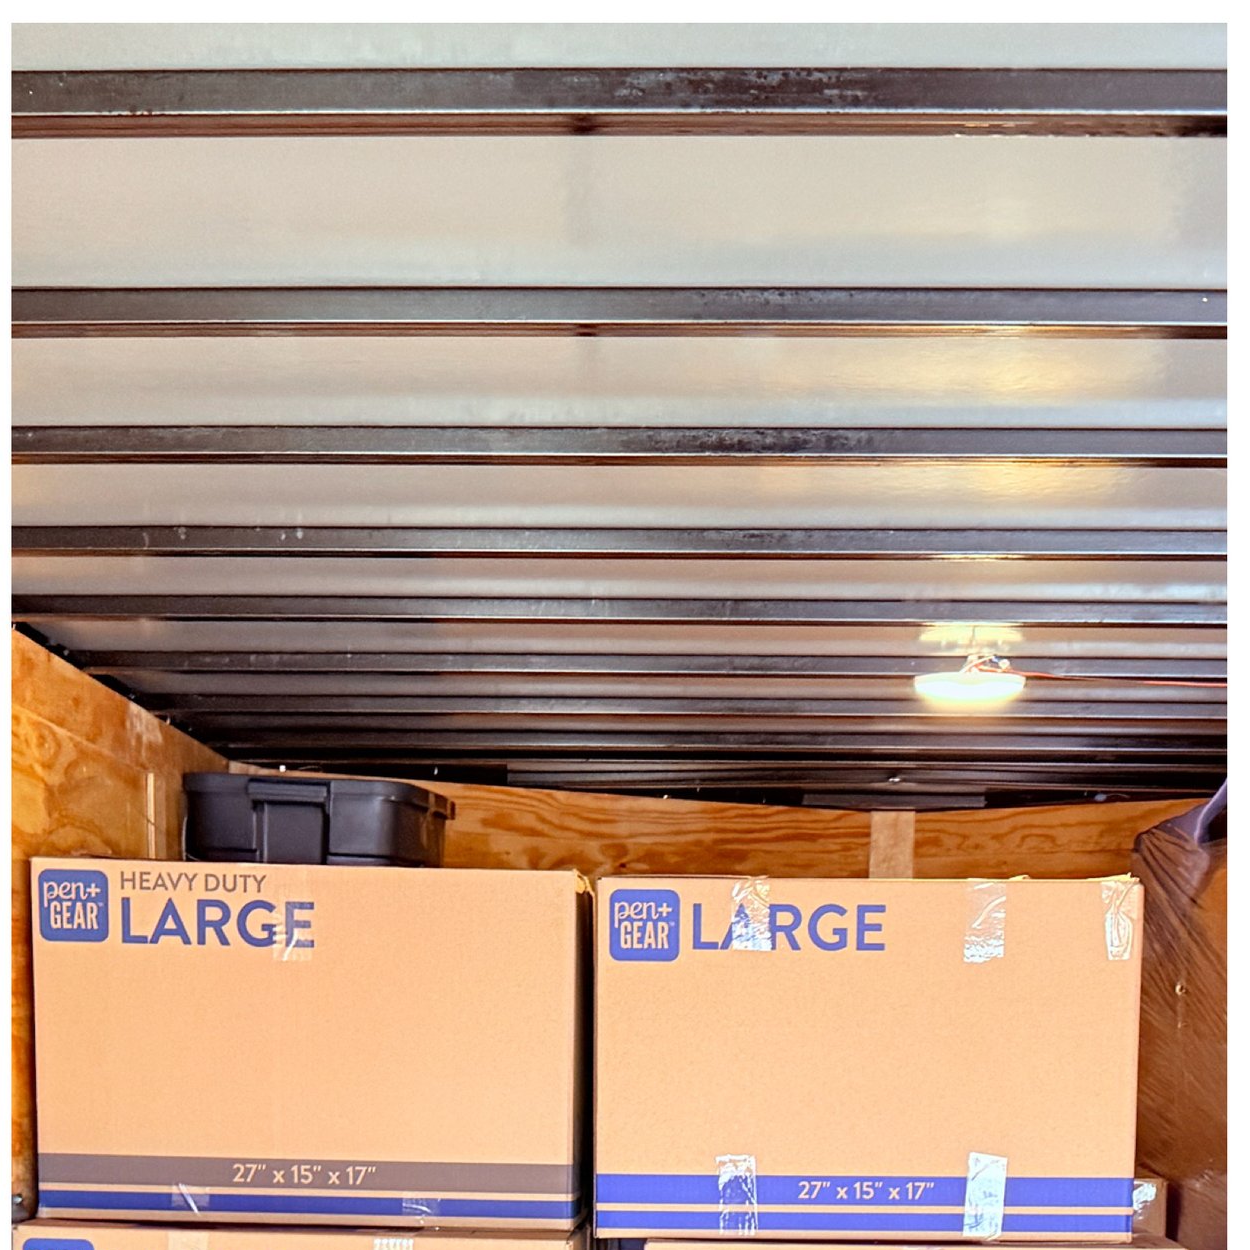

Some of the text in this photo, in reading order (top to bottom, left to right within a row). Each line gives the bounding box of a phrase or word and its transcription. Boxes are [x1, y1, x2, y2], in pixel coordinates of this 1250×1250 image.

[44, 882, 100, 906] pen+
[121, 871, 266, 893] HEAVY DUTY
[50, 901, 98, 929] GEAR
[121, 897, 314, 948] LARGE
[615, 902, 672, 927] pen+
[693, 903, 886, 951] LARGE
[621, 921, 668, 948] GEAR
[233, 1164, 376, 1185] 27" x 15" x 17"
[798, 1181, 934, 1199] 27" x 15" x 17"
